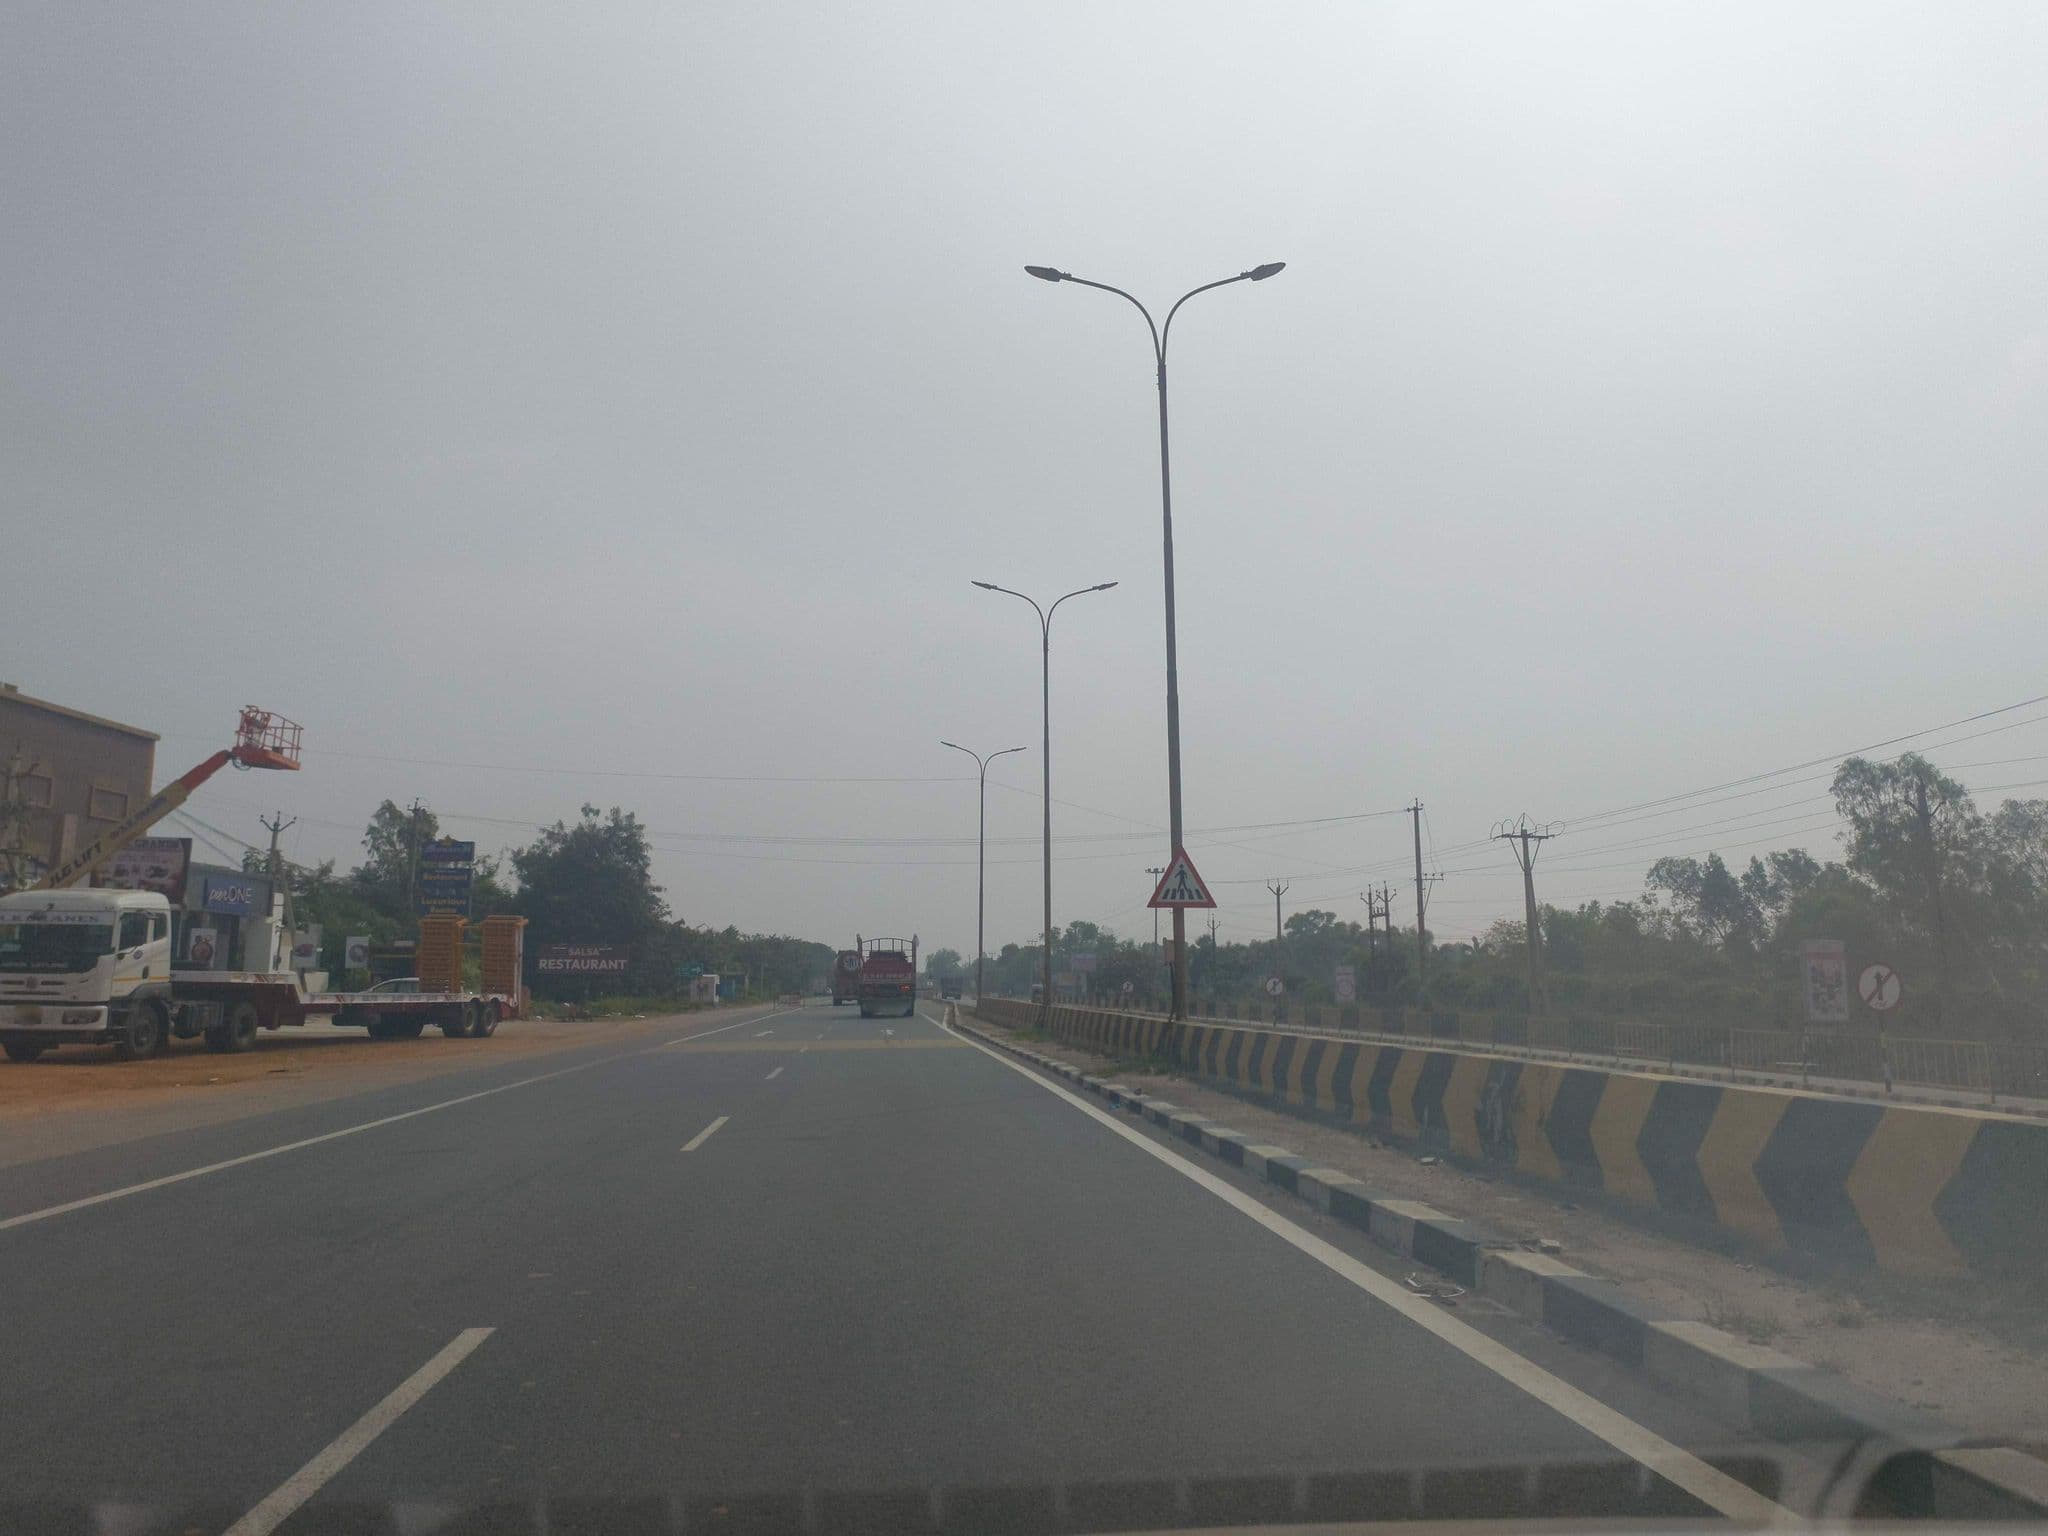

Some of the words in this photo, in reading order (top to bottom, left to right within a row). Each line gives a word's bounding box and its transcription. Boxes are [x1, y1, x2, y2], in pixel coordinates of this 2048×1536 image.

[49, 865, 72, 888] JLG
[73, 840, 102, 869] LIFT
[567, 947, 600, 956] SALSA
[538, 959, 628, 970] RESTAURANT
